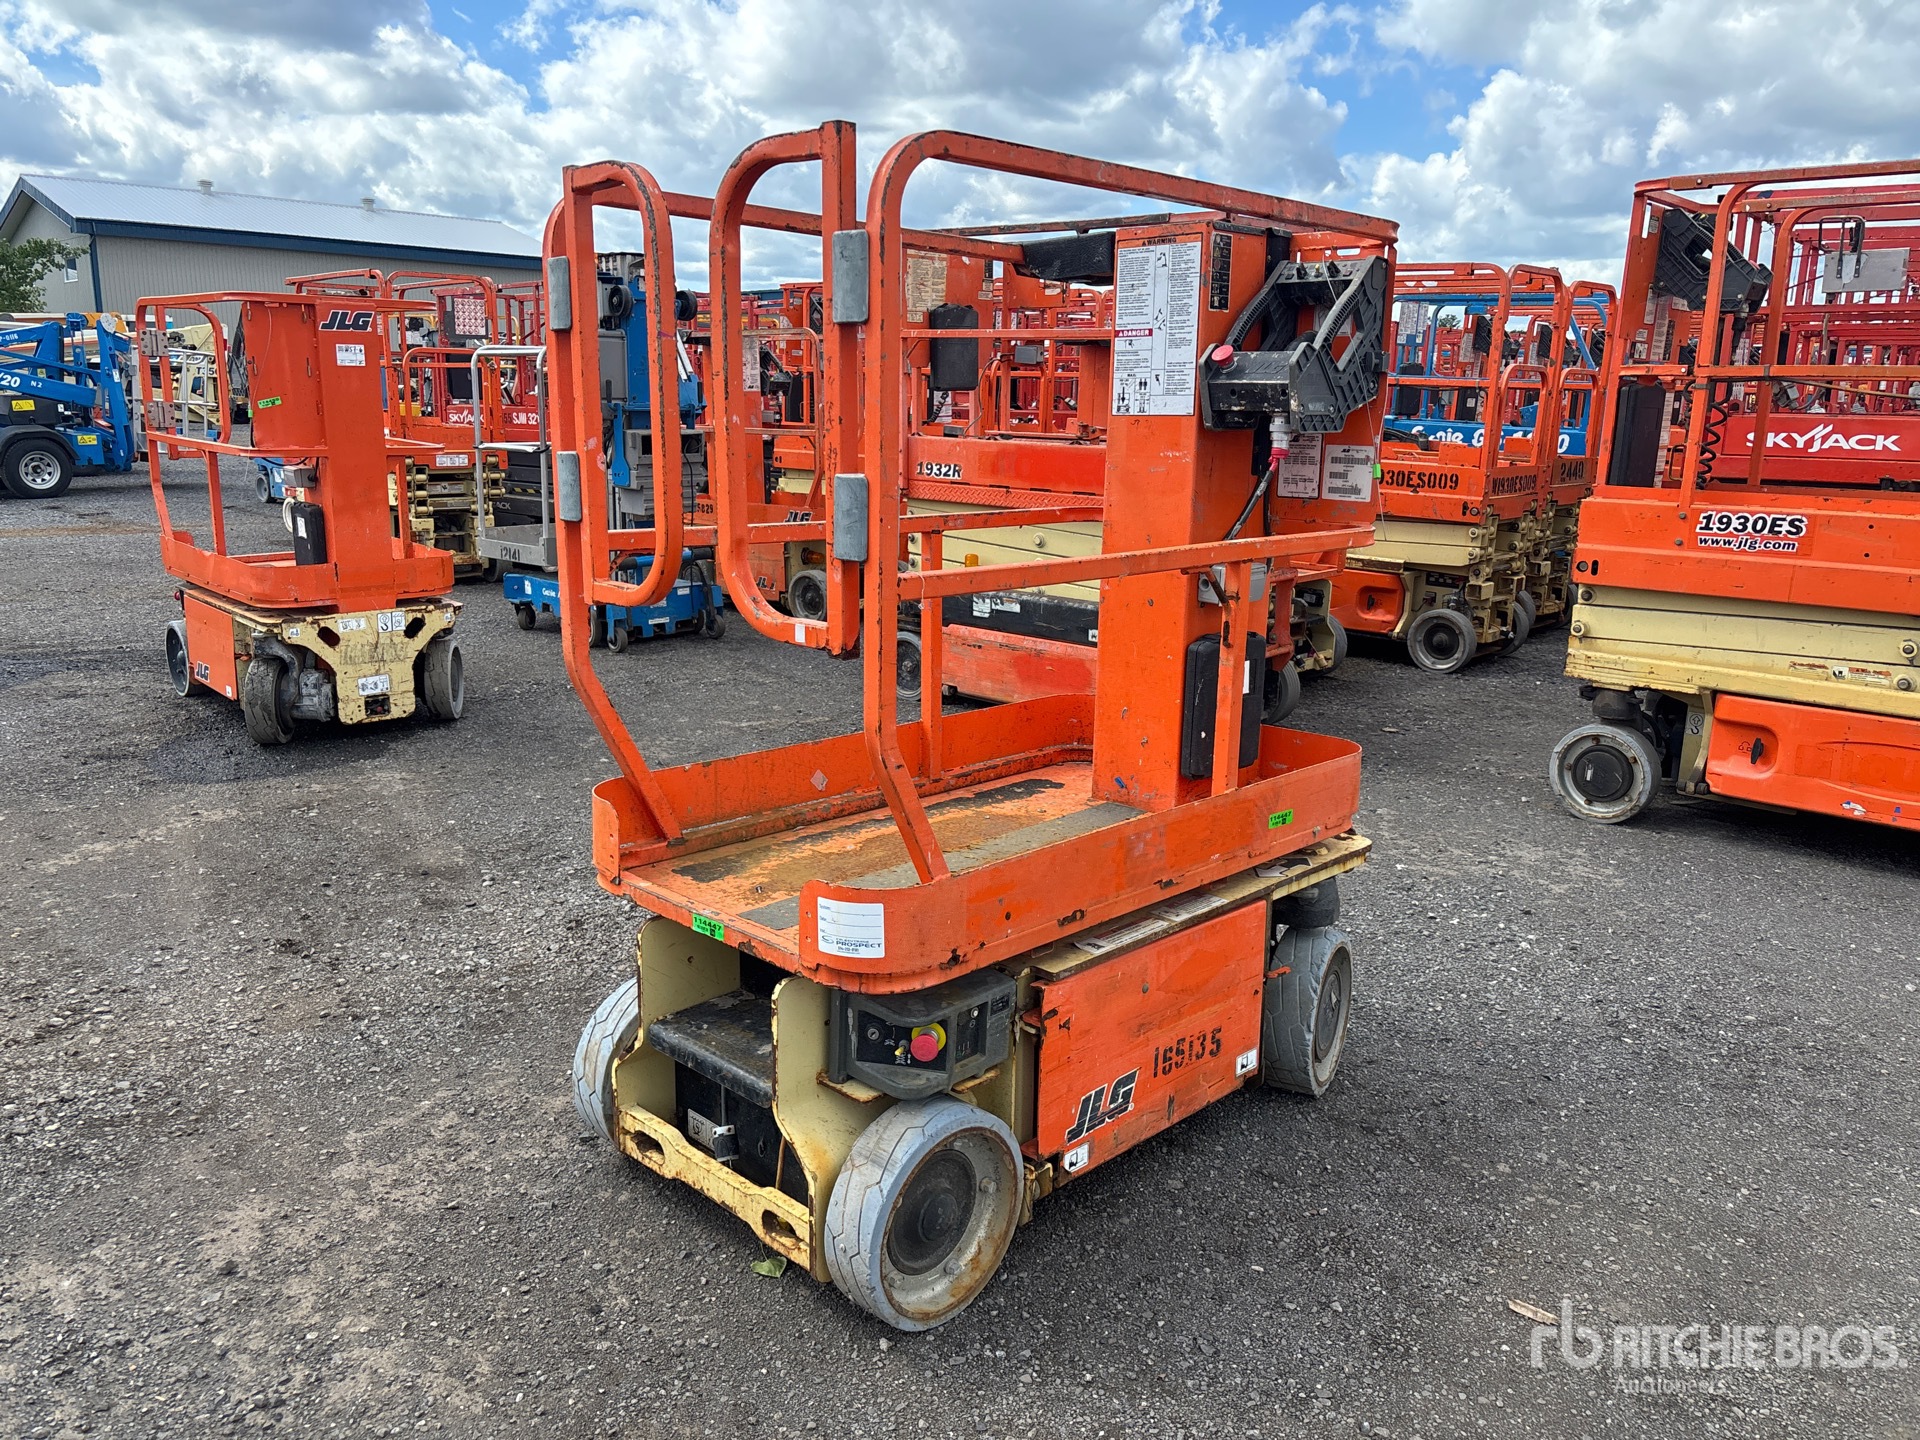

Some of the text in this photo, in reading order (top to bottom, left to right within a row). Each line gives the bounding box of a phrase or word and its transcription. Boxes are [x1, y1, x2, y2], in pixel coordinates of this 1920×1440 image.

[1148, 237, 1176, 246] WARNING
[319, 310, 374, 332] JLG
[1123, 329, 1150, 337] DANGER
[449, 409, 485, 424] SKYJAK
[1746, 423, 1902, 453] SKYJACK
[916, 461, 963, 479] 1932R
[784, 510, 812, 523] JLG
[1697, 511, 1807, 537] 1930ES
[1698, 536, 1798, 552] www.jlg.com
[195, 661, 210, 683] JLG
[836, 940, 882, 949] PROSPECT
[1065, 1066, 1142, 1146] JLG
